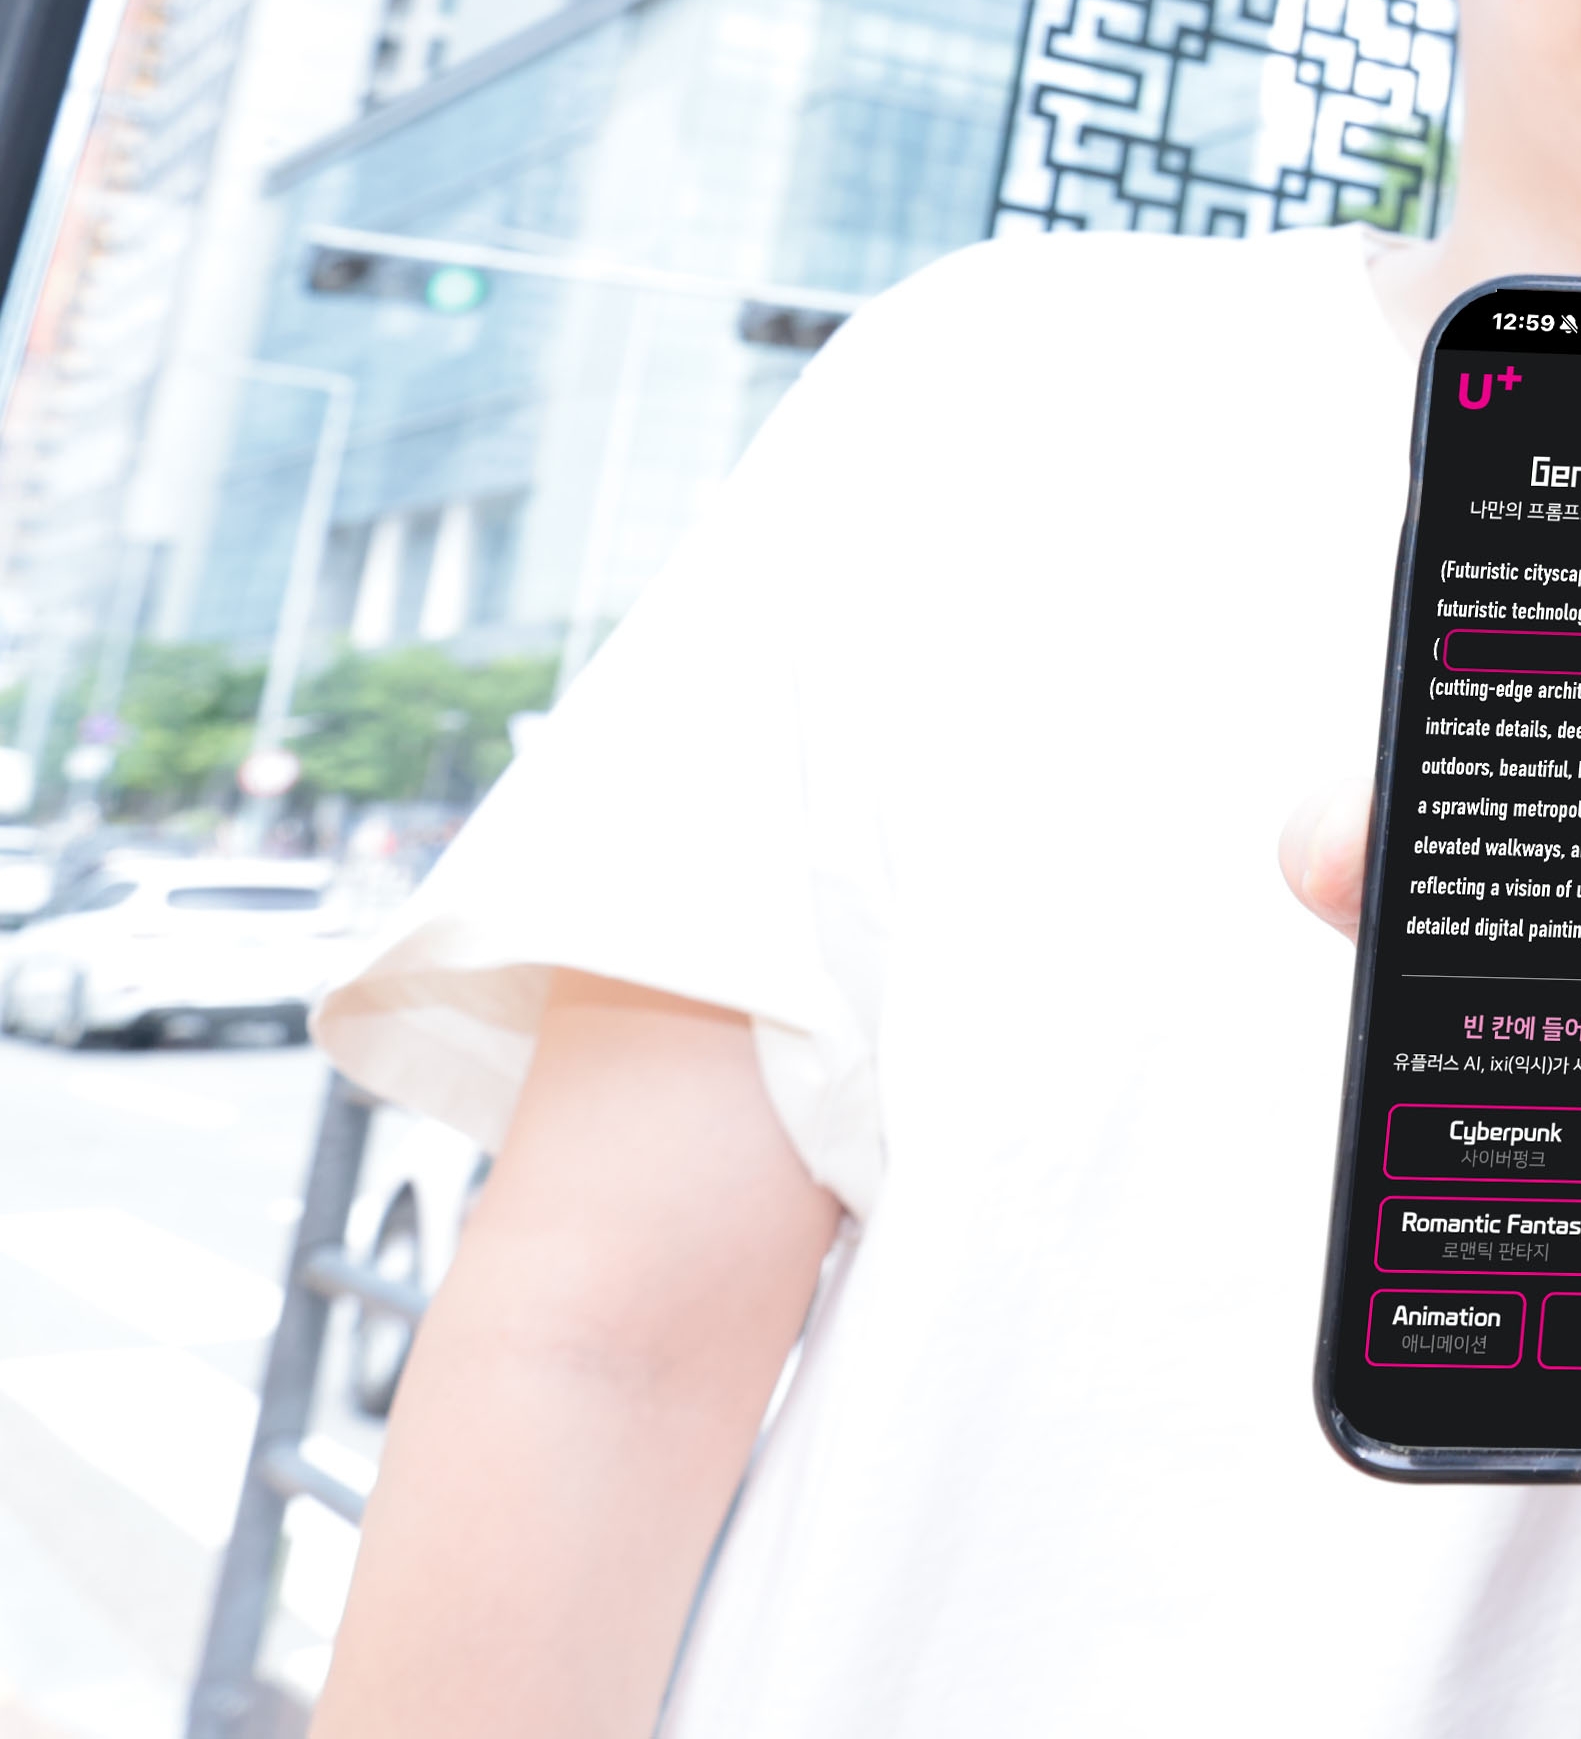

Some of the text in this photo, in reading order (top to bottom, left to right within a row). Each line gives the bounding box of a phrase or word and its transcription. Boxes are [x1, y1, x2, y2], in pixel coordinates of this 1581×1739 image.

[1493, 313, 1555, 331] 12:59
[1458, 366, 1522, 410] U+
[1471, 500, 1522, 520] 나만의
[1441, 560, 1519, 583] (Futuristic
[1437, 599, 1507, 618] futuristic
[1430, 677, 1533, 702] (cutting-edge
[1426, 717, 1490, 736] intricate
[1496, 719, 1551, 740] details,
[1410, 876, 1485, 900] reflecting
[1490, 883, 1499, 896] a
[1505, 878, 1550, 897] vision
[1556, 879, 1572, 898] of
[1464, 1015, 1484, 1039] 빈
[1492, 1015, 1536, 1040] 칸에
[1393, 1053, 1459, 1072] 유플러스
[1464, 1056, 1484, 1073] AI,
[1491, 1055, 1569, 1075] ixi(익시)가
[1450, 1121, 1562, 1145] Cyberpunk
[1461, 1149, 1545, 1169] 사이버펑크
[1402, 1212, 1501, 1233] Romantic
[1442, 1242, 1548, 1261] 로맨틱 판타지
[1392, 1305, 1501, 1327] Animation
[1402, 1335, 1486, 1354] 애니메이션
